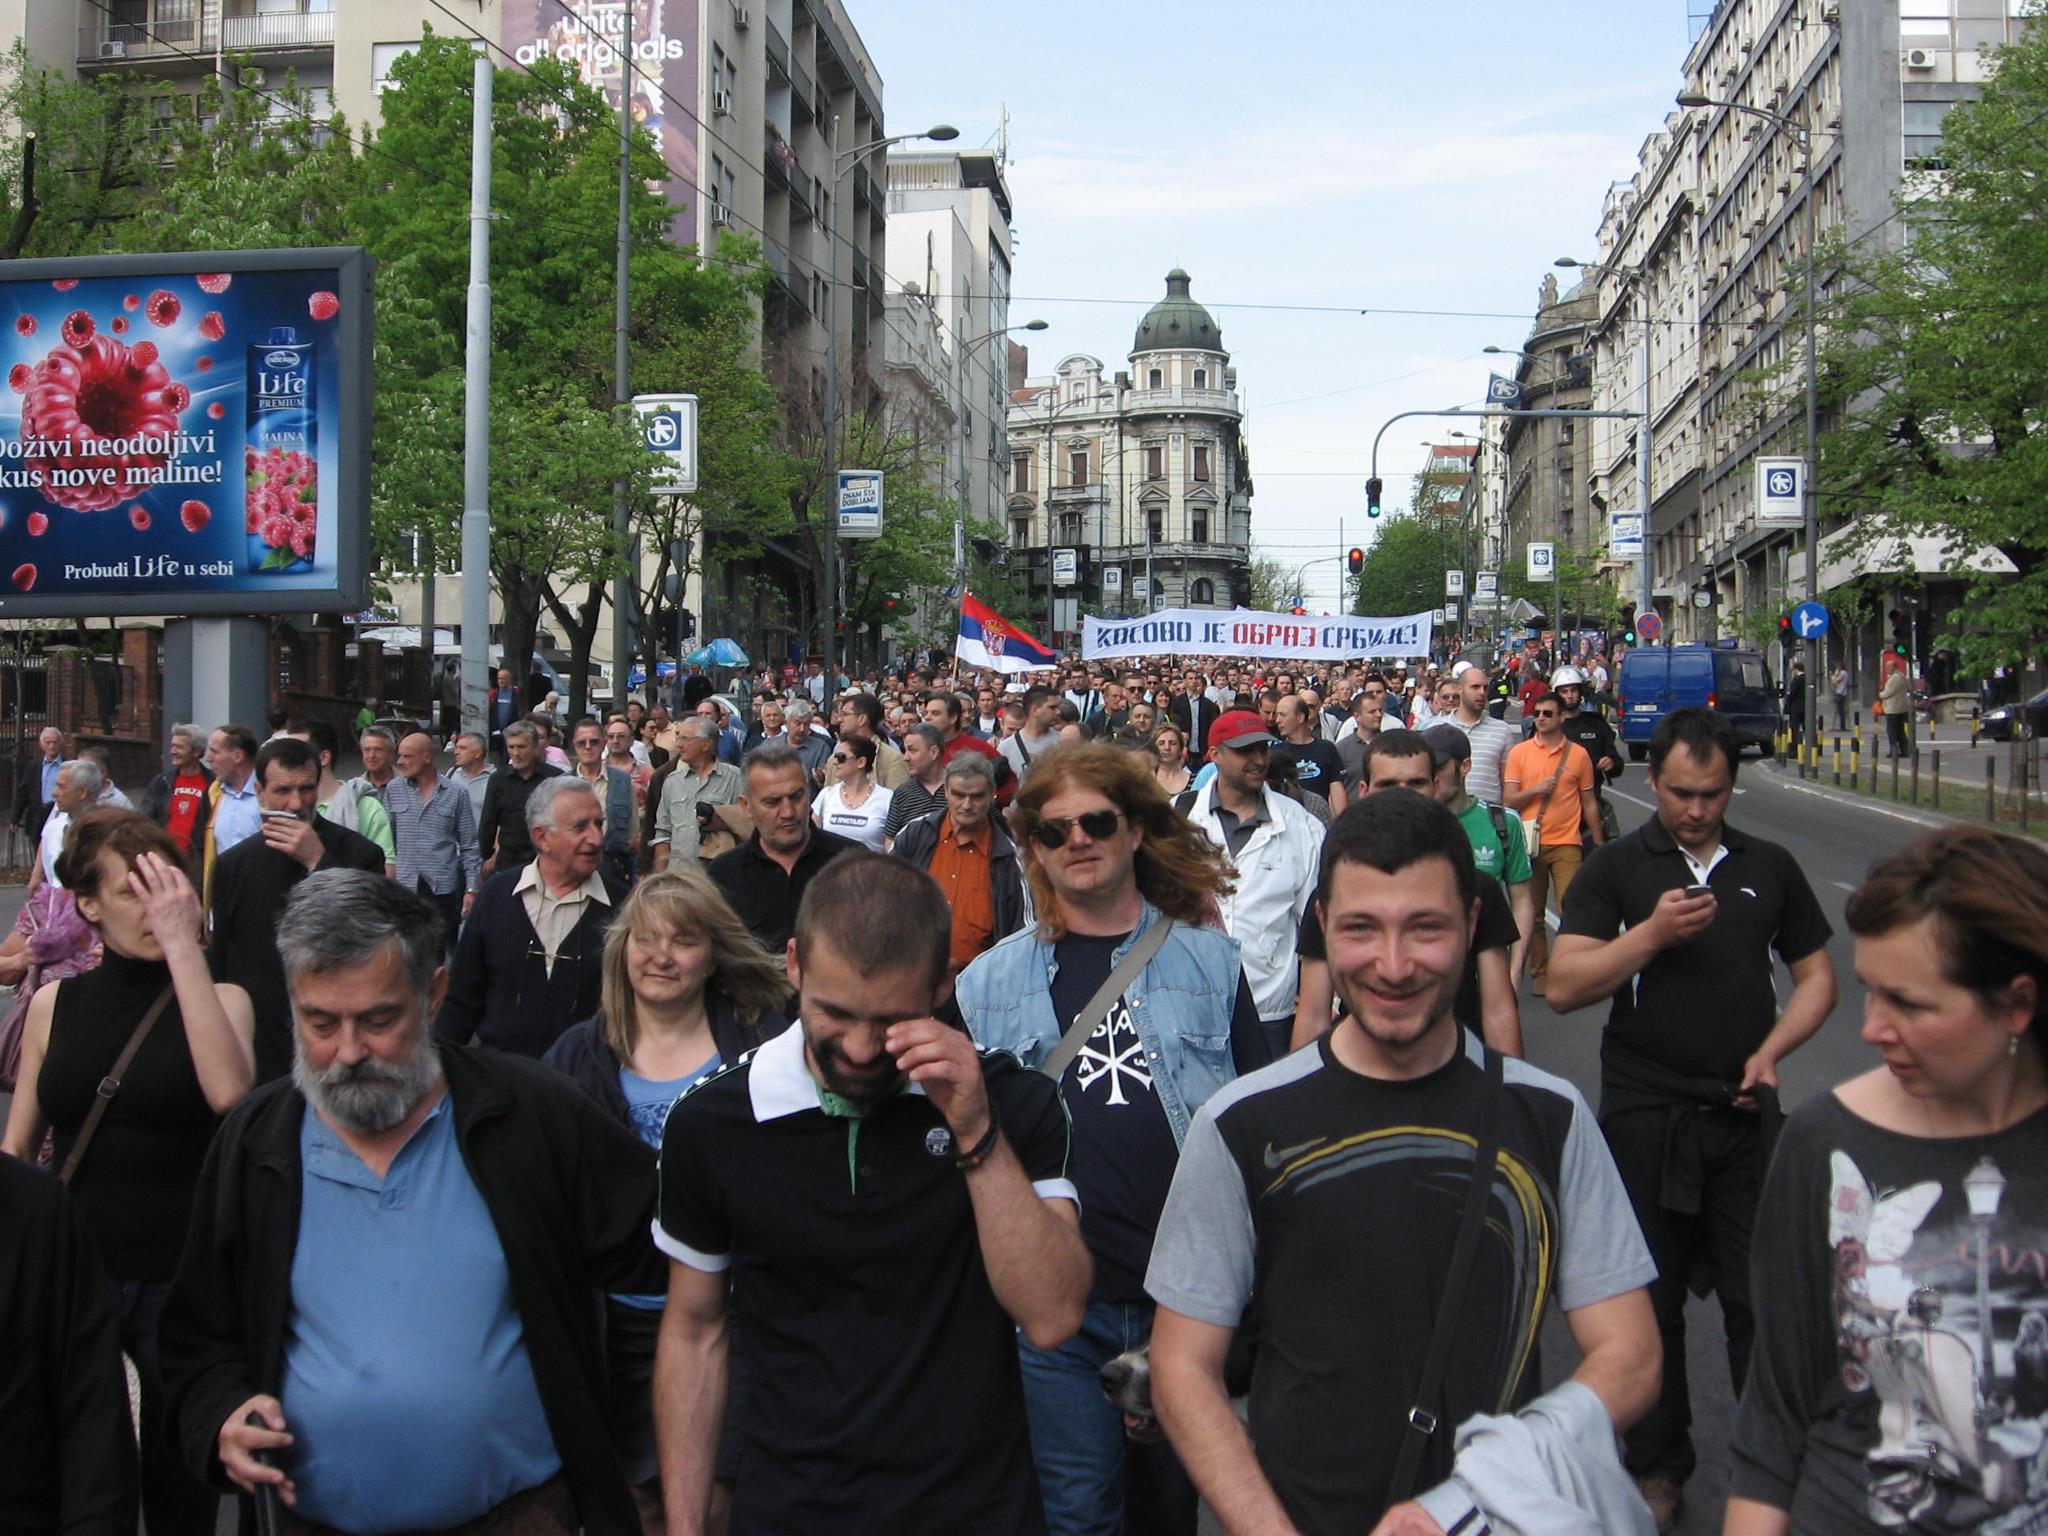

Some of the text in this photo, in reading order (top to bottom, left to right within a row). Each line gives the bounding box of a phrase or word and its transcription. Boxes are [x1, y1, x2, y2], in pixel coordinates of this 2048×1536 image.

[562, 9, 637, 34] unite
[515, 34, 684, 68] all originals
[258, 371, 306, 394] Life
[258, 399, 305, 408] PREMIUM
[80, 429, 216, 459] neodoljivi
[260, 431, 305, 442] MALINA
[52, 467, 116, 487] nove
[125, 460, 223, 485] maline!
[64, 554, 234, 579] Probudi Life u sebi
[1097, 621, 1192, 648] КОСОВО
[1199, 623, 1226, 643] ЈЕ
[1232, 623, 1316, 648] ОБРАЗ
